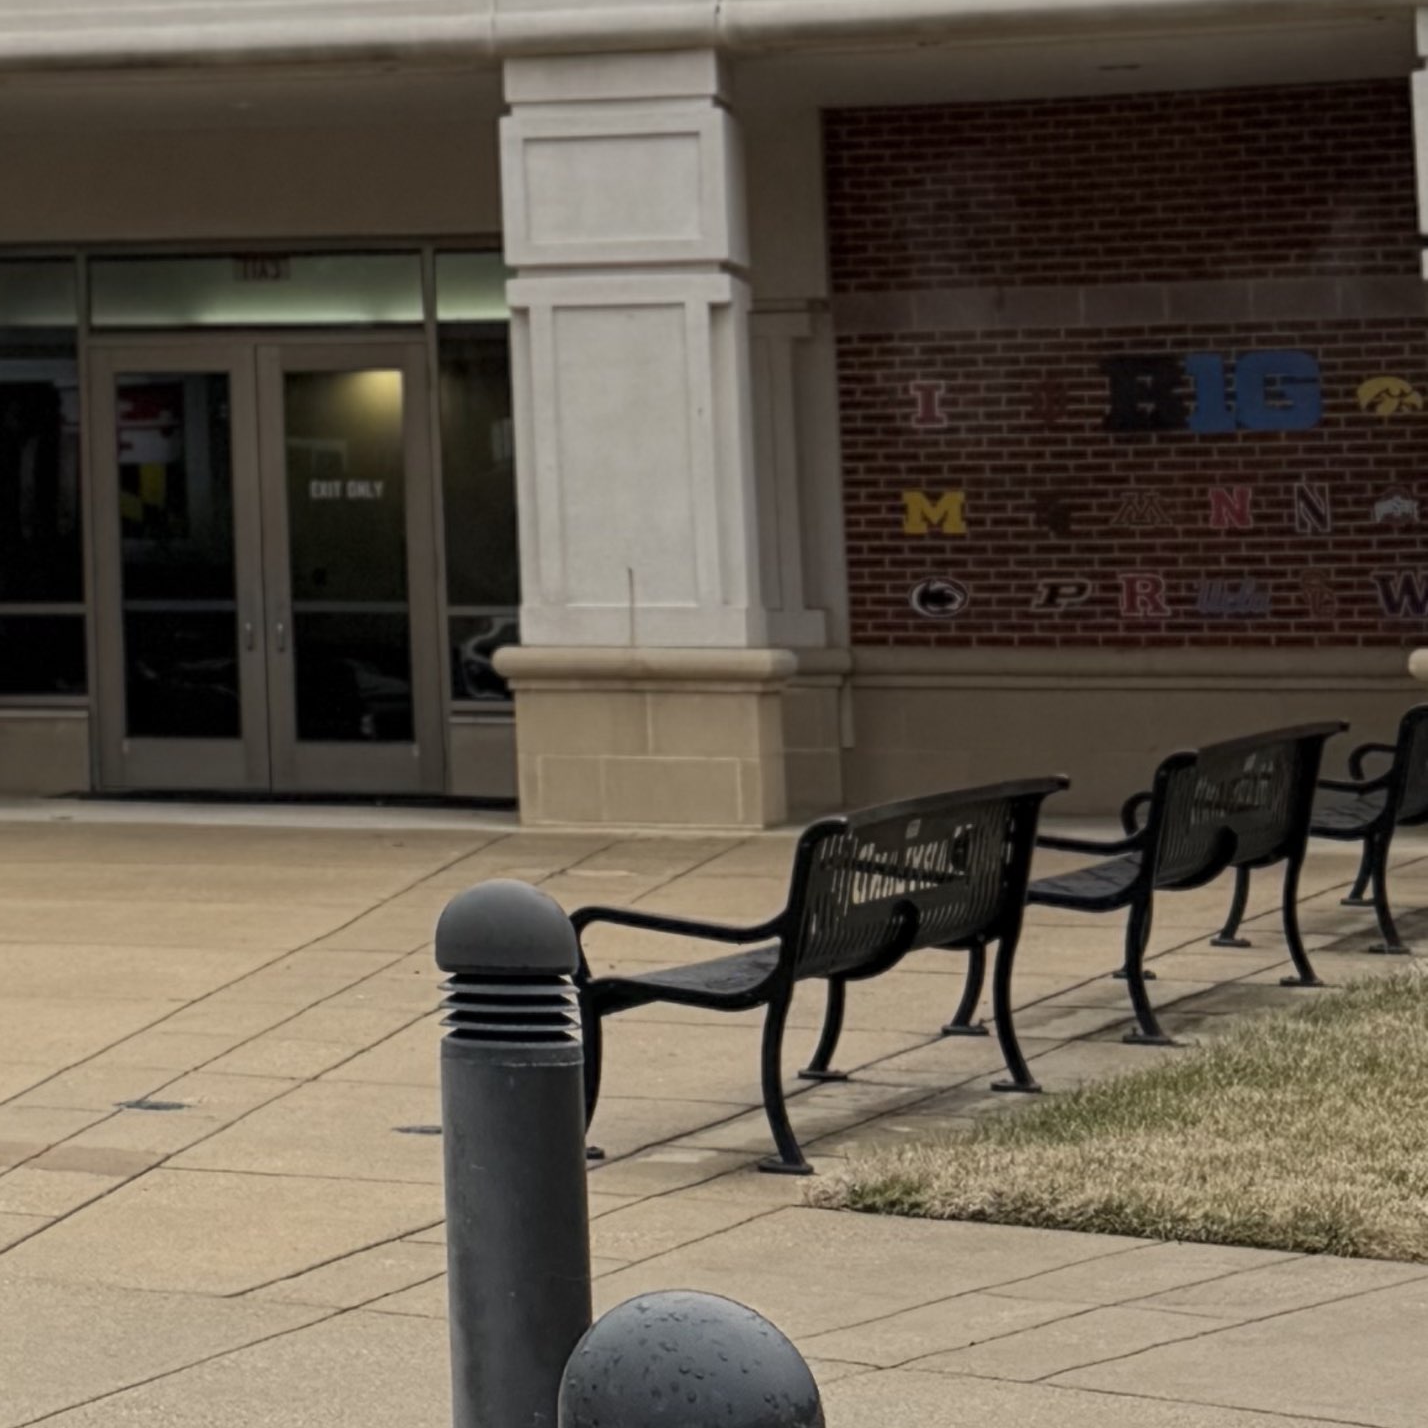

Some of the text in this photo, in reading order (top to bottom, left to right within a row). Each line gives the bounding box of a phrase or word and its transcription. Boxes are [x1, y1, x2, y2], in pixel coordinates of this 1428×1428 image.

[901, 490, 968, 534] M
[1209, 485, 1253, 530] N
[1293, 483, 1332, 532] N
[1030, 578, 1092, 612] P
[1117, 573, 1171, 617] R
[1370, 570, 1428, 617] W
